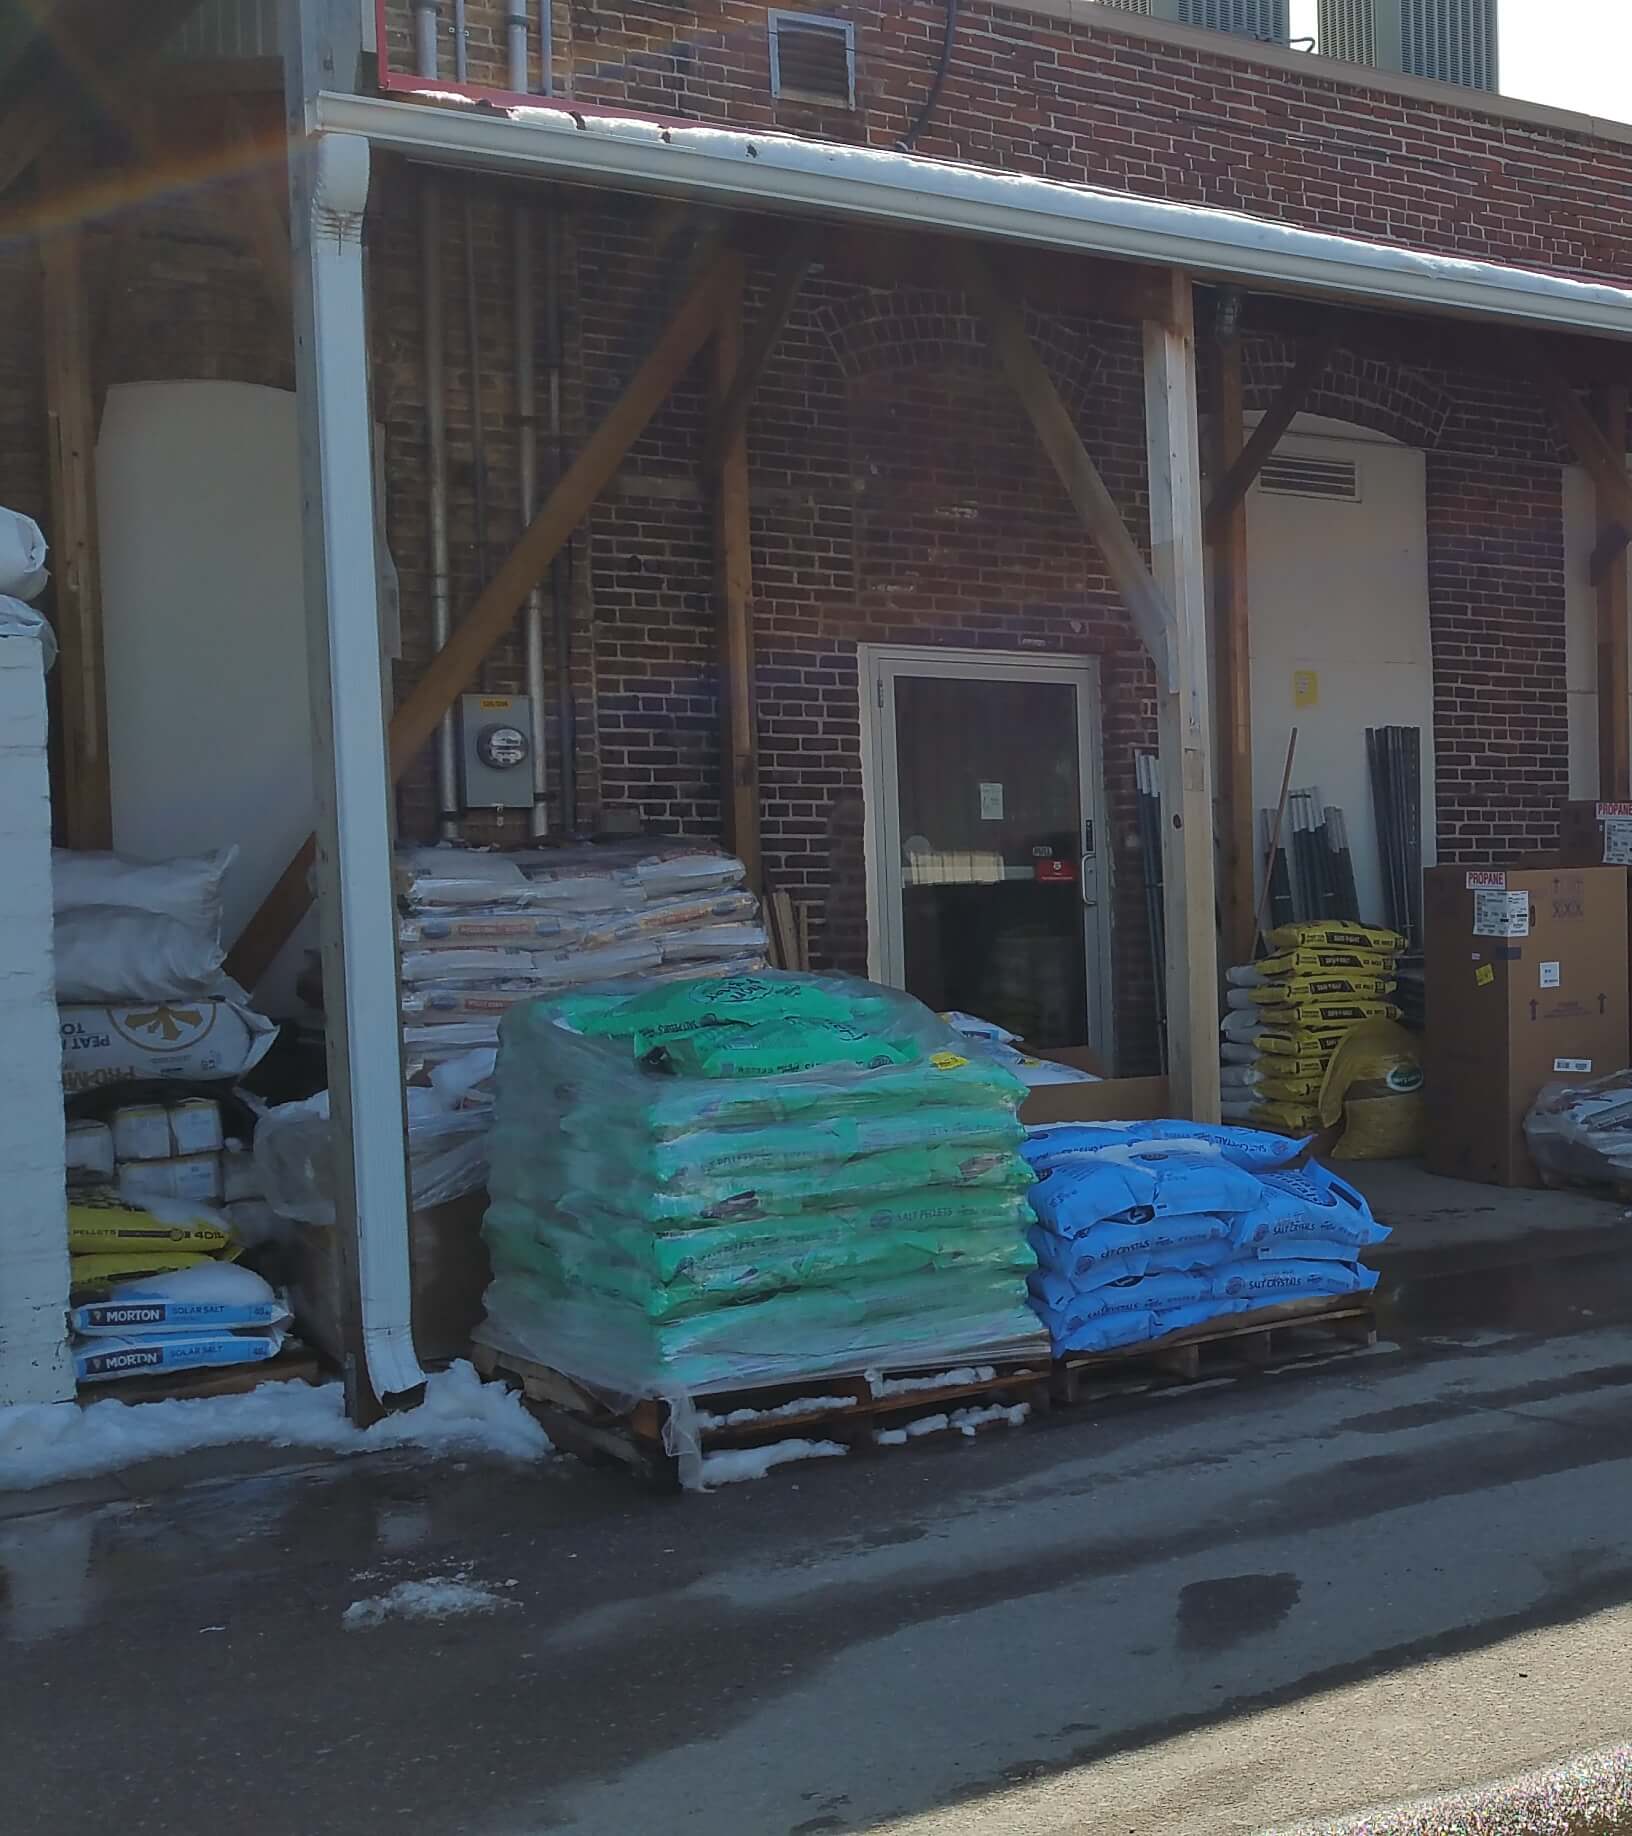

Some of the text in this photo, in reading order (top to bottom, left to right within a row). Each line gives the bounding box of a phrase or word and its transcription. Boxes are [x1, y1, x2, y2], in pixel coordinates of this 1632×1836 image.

[1598, 803, 1632, 816] PROPANE
[1468, 872, 1504, 886] PROPANE
[72, 1034, 111, 1049] PEAT
[73, 1228, 117, 1236] PELLETS
[1266, 1277, 1301, 1289] CRYSTALS
[106, 1309, 160, 1322] MORTON
[172, 1306, 202, 1315] SOLAR
[202, 1305, 225, 1314] SALT
[105, 1352, 158, 1369] MORTON
[170, 1348, 202, 1357] SOLAR
[202, 1345, 223, 1355] SALT
